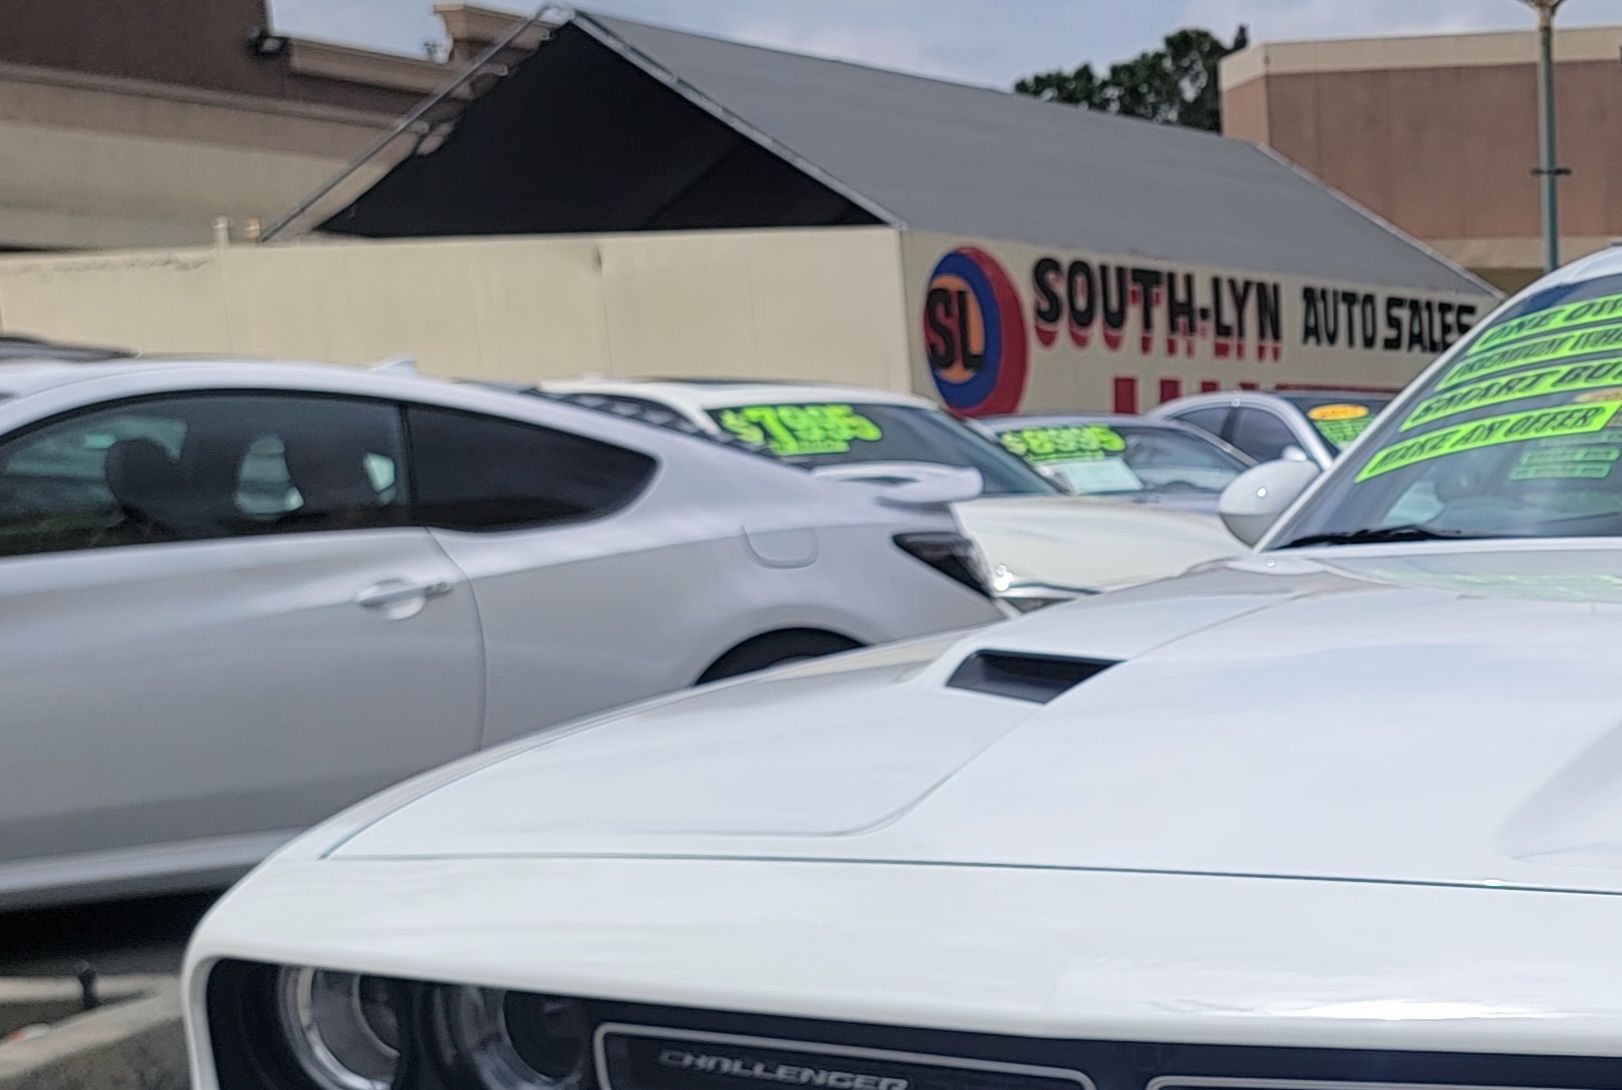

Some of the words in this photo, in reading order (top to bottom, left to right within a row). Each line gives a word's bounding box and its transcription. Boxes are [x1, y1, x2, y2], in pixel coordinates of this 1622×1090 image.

[926, 287, 986, 373] SL
[1033, 257, 1282, 346] SOUTH-LYN
[1302, 286, 1378, 350] AUTO
[1383, 297, 1477, 354] SALES
[1479, 308, 1566, 347] ONE
[1411, 369, 1560, 422] SMART
[1367, 429, 1462, 474] MAKE
[1449, 419, 1511, 448] AN
[1503, 405, 1606, 438] OFFER
